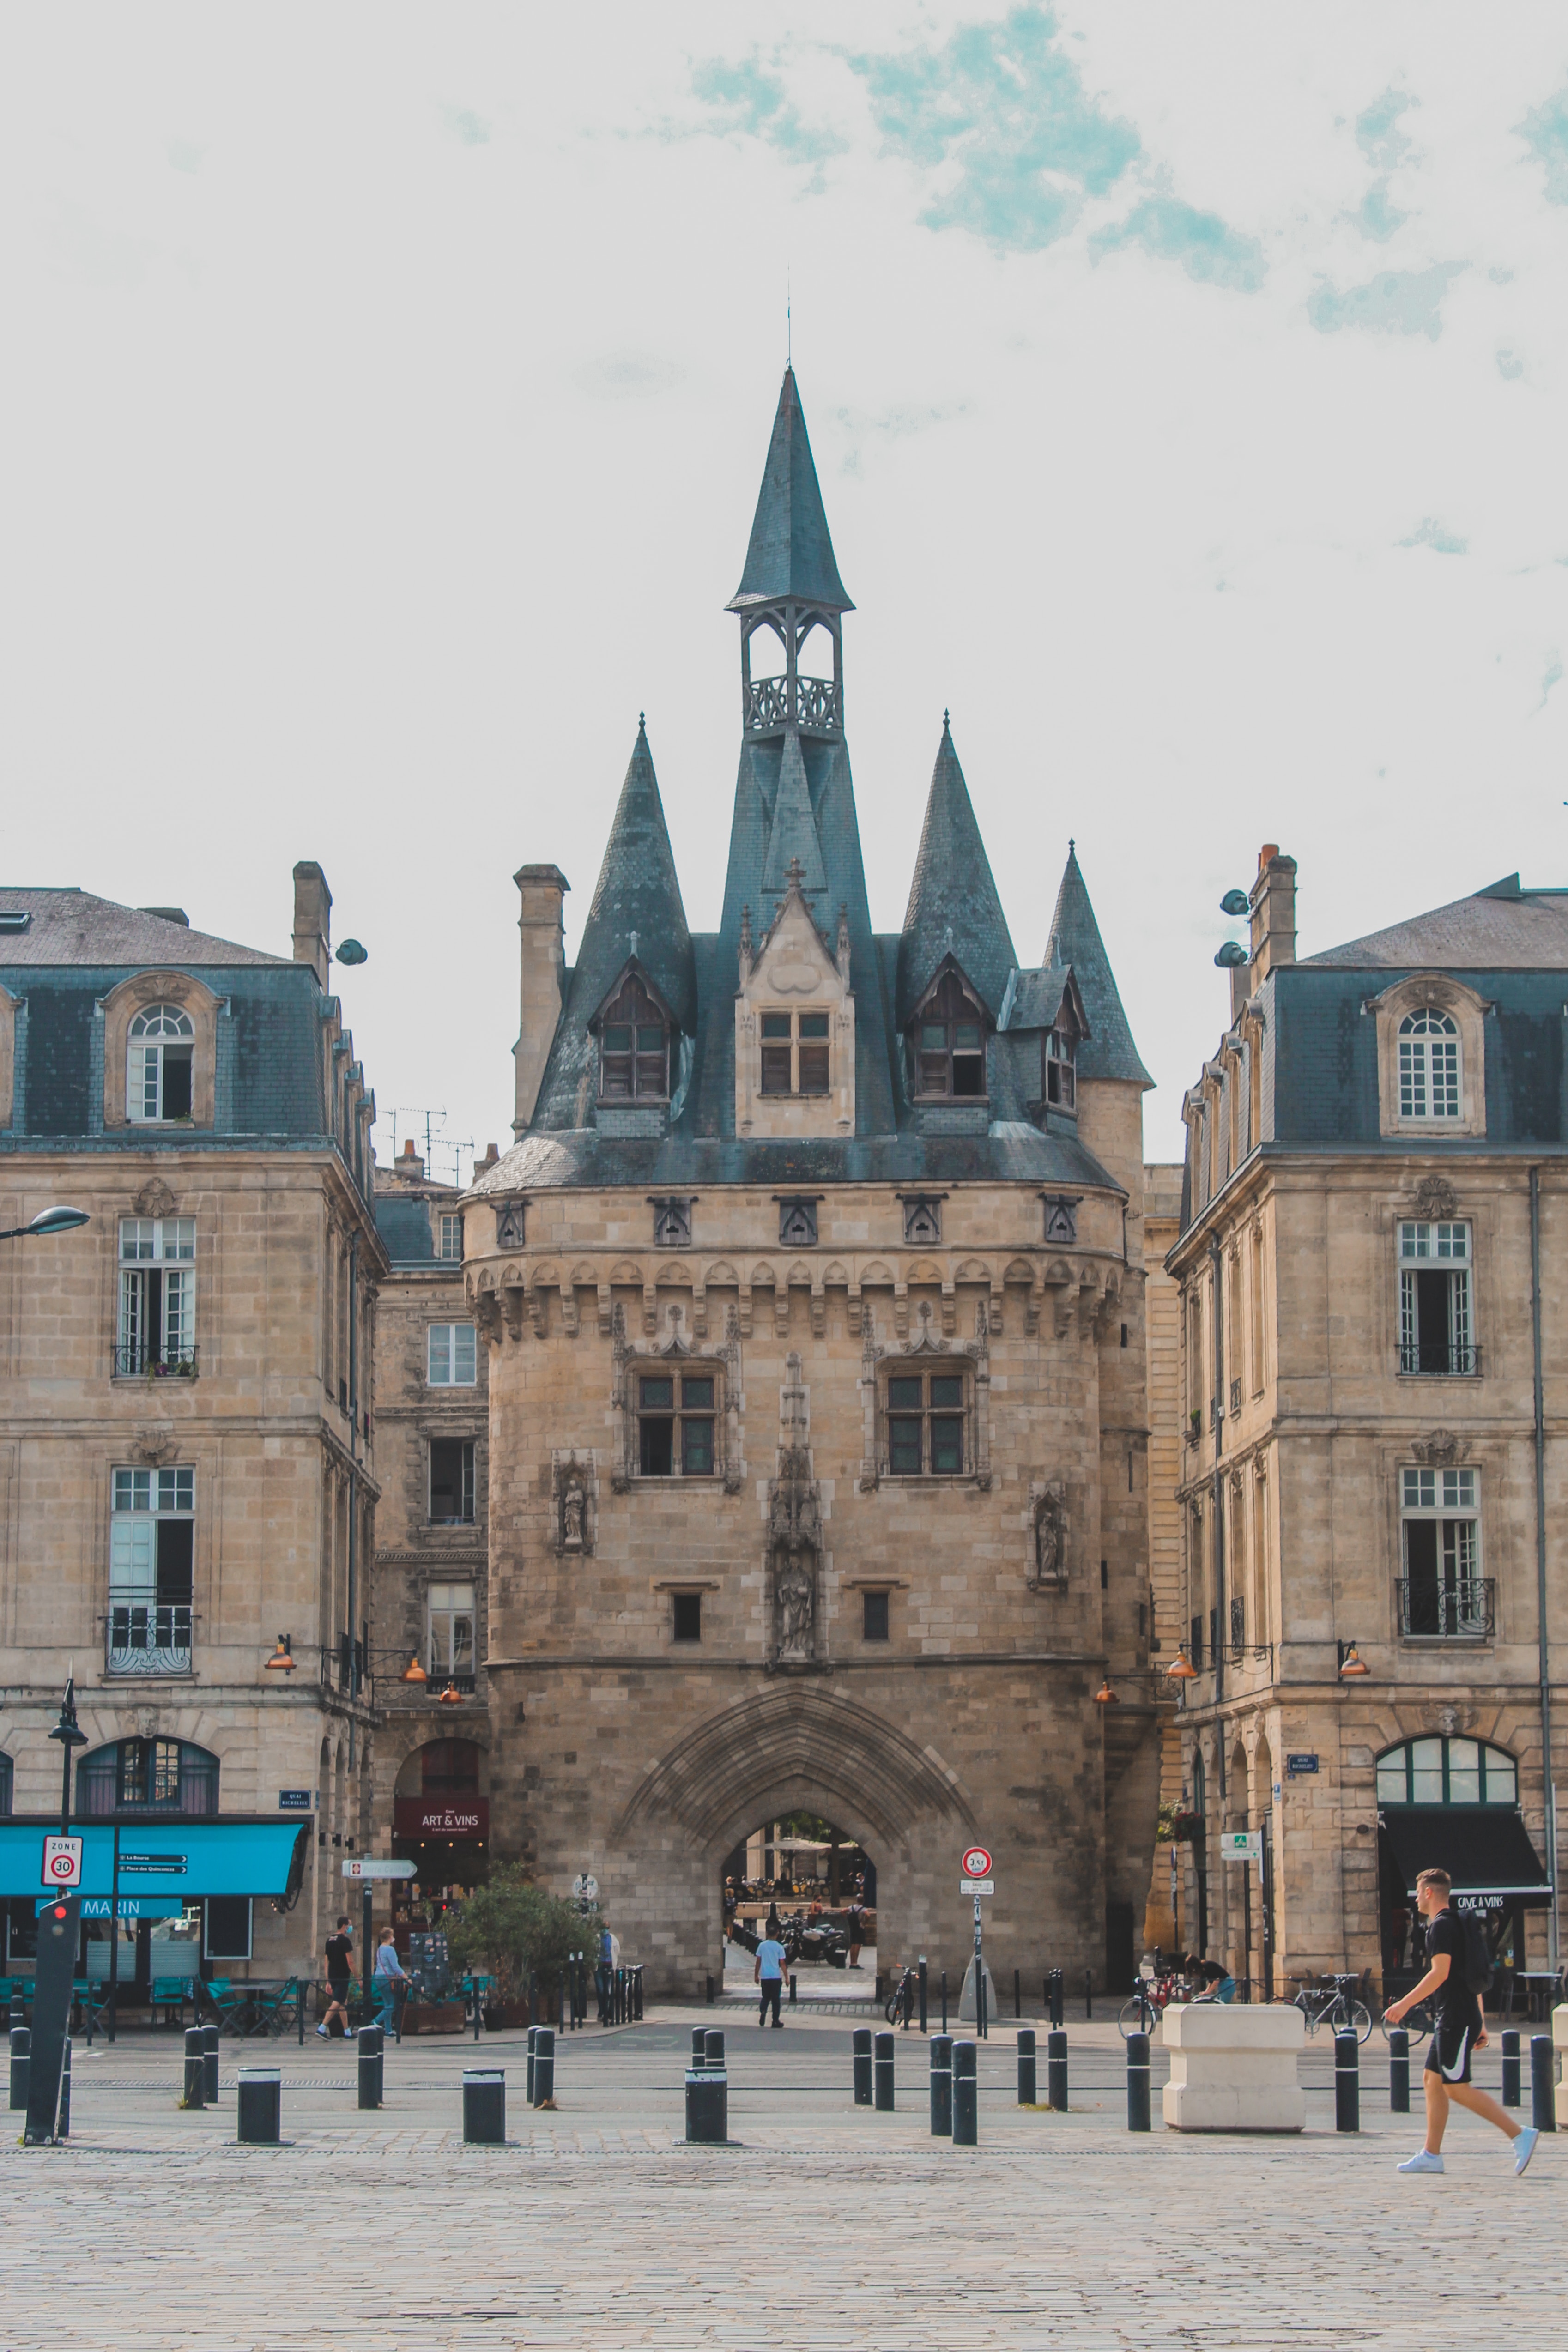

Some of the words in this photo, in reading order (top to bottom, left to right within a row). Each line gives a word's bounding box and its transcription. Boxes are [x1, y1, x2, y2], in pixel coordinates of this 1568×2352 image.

[422, 1815, 442, 1826] ART
[444, 1815, 453, 1826] &
[454, 1815, 478, 1826] VINS
[56, 1861, 70, 1871] 30
[1458, 1897, 1477, 1908] CAVE
[1478, 1896, 1483, 1907] A
[1484, 1896, 1503, 1908] VINS
